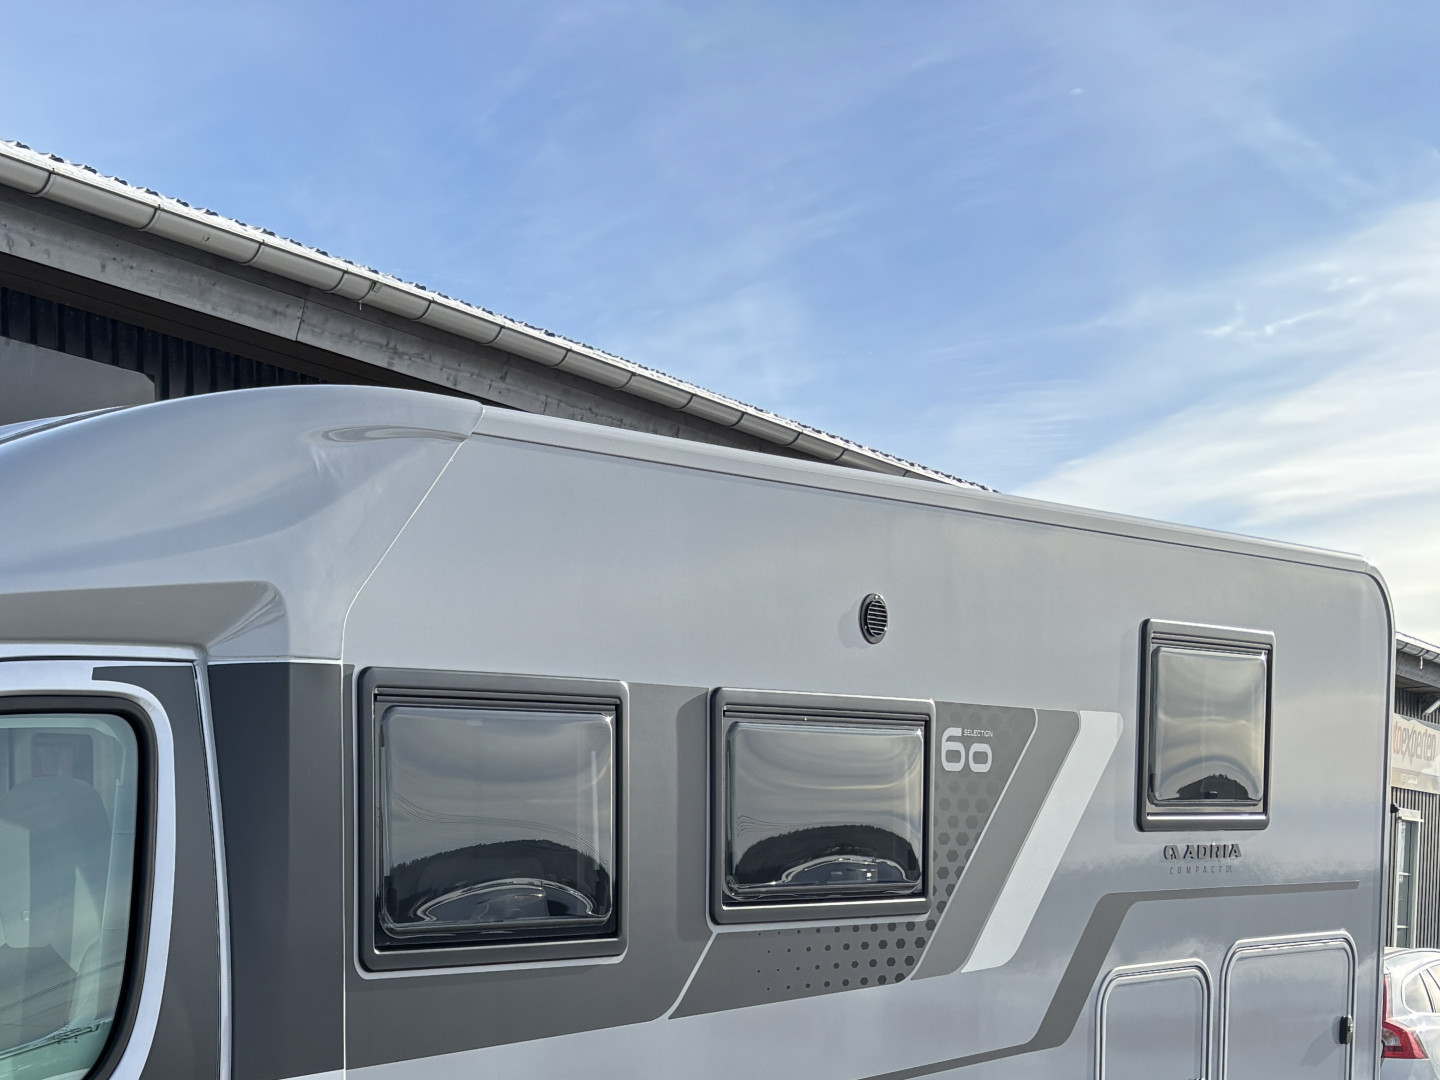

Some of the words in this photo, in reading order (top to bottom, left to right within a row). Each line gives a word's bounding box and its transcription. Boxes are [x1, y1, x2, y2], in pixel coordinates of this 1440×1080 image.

[963, 728, 994, 738] SELECTION
[1393, 721, 1437, 766] toexperten
[941, 727, 992, 773] 60
[1182, 843, 1242, 860] ADRIA
